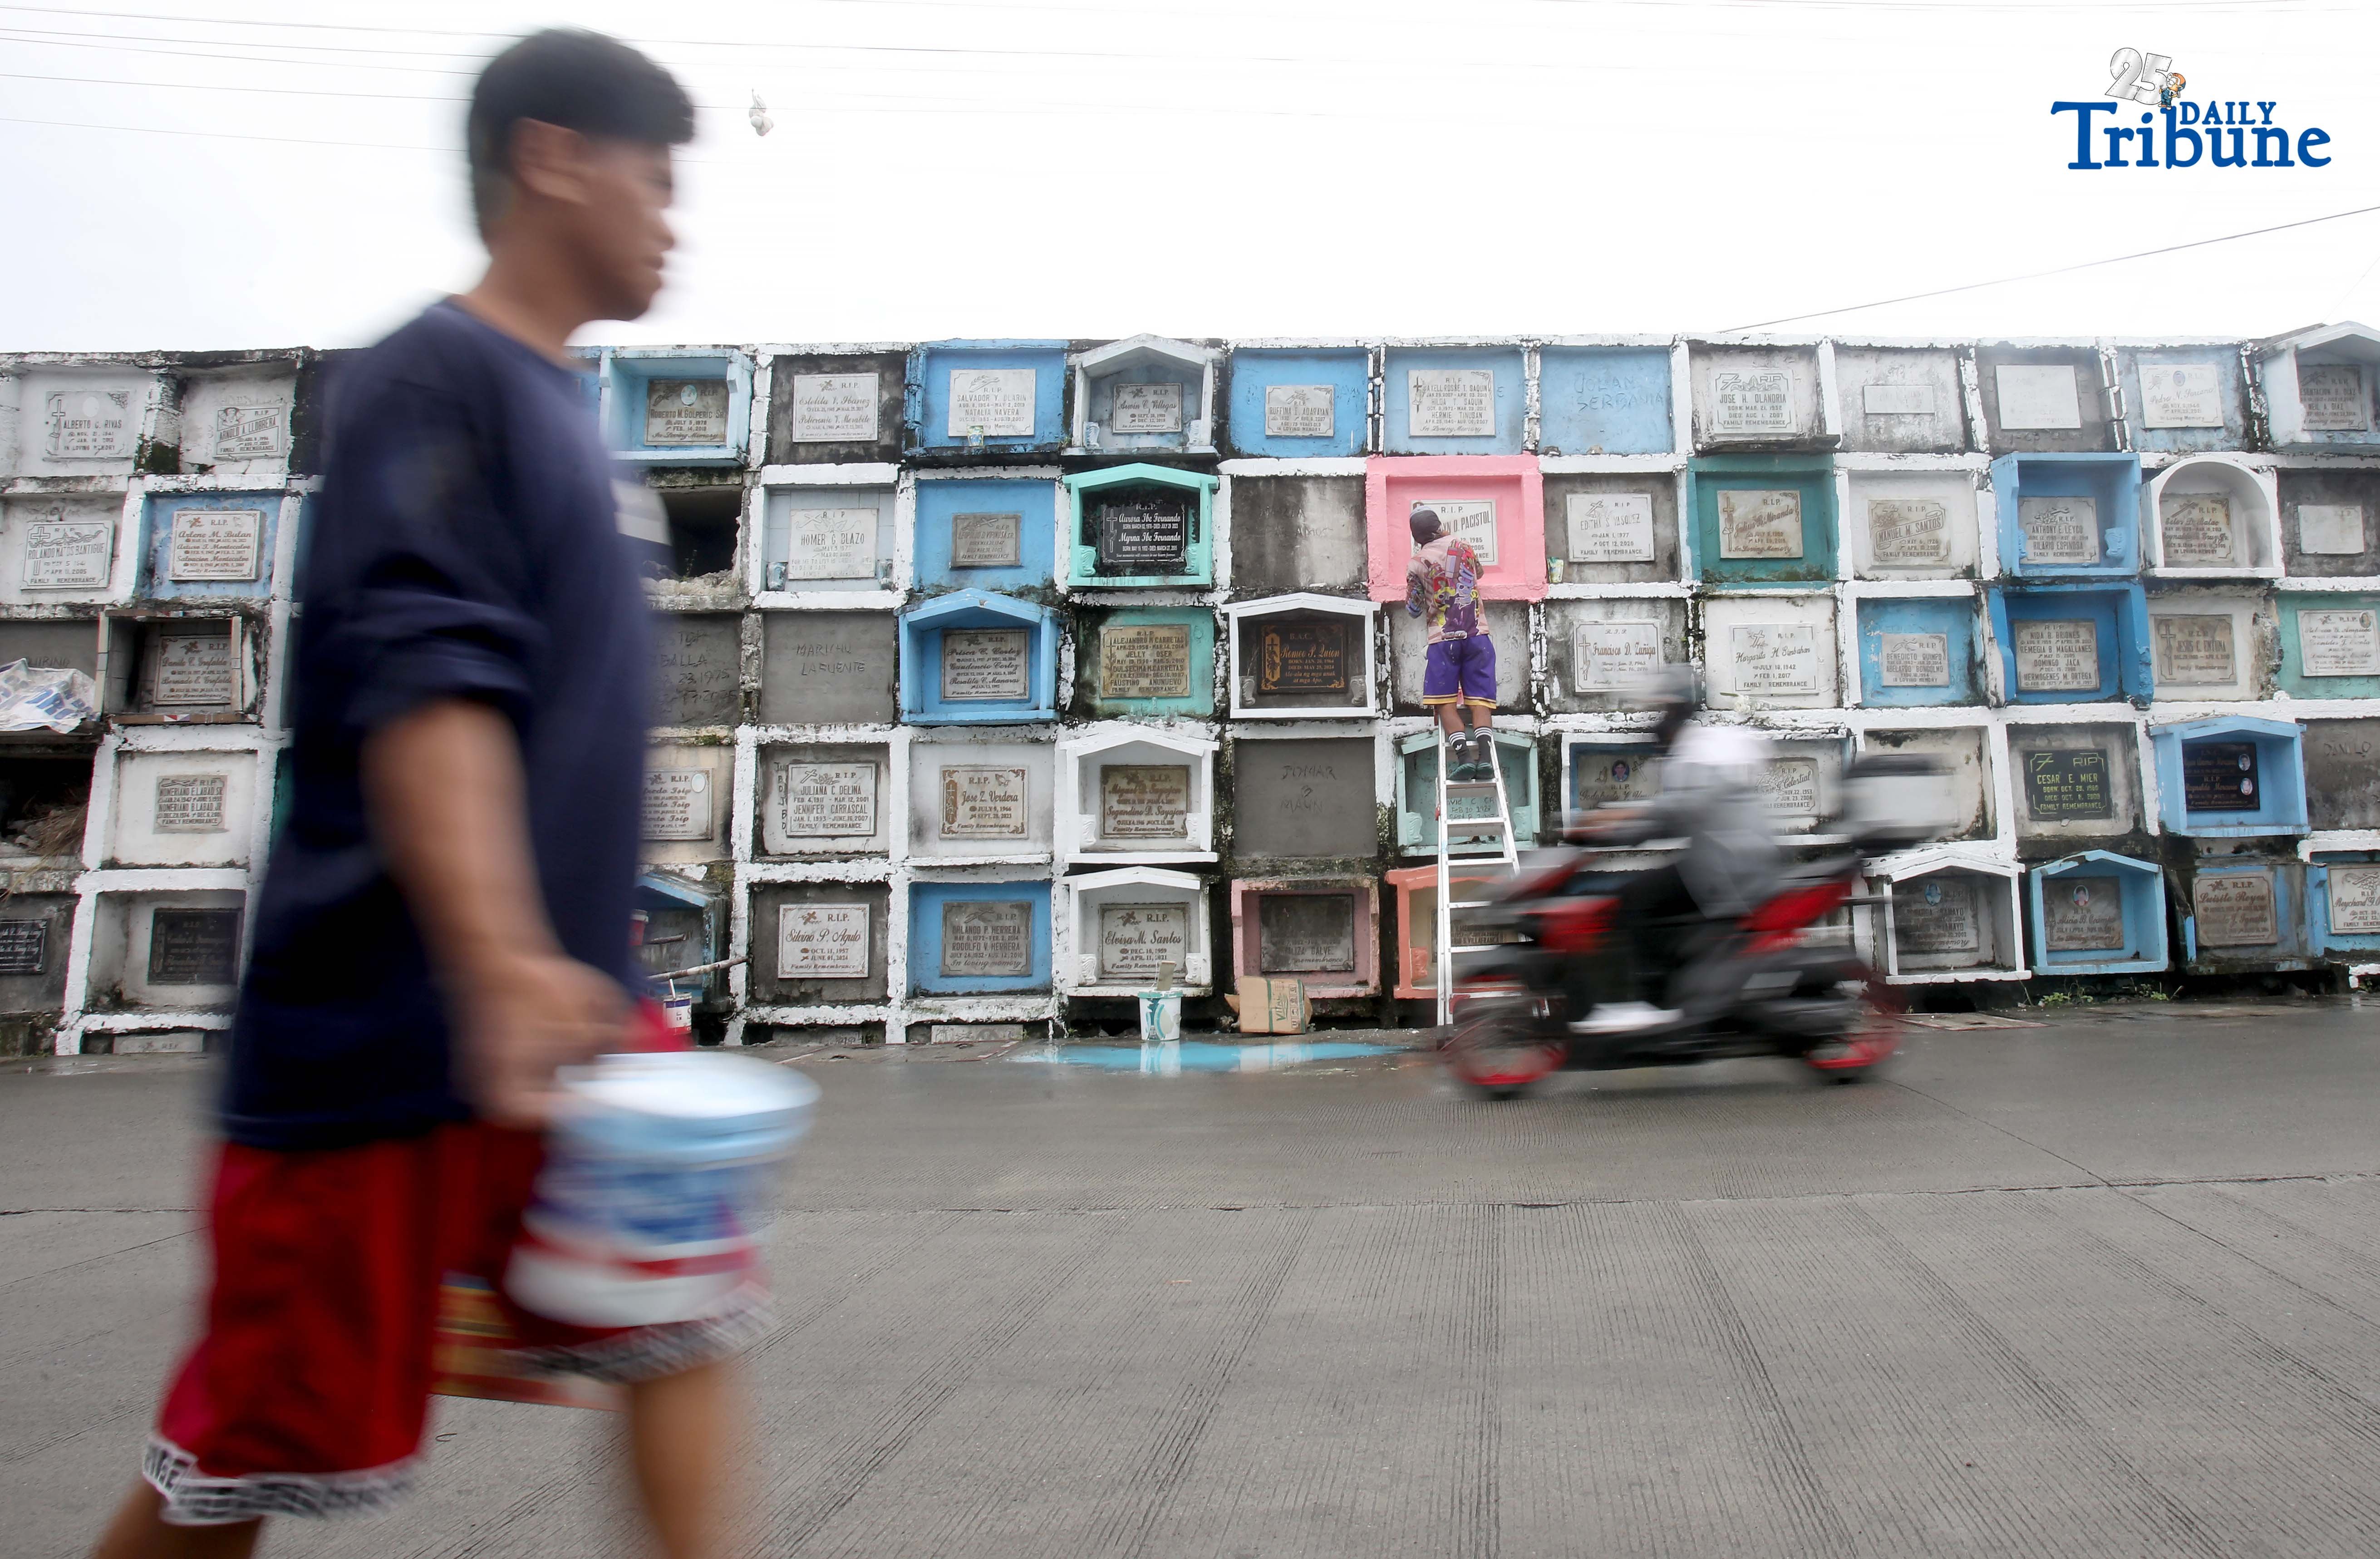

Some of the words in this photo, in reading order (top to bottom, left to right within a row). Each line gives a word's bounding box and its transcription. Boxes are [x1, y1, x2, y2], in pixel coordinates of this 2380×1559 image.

[1720, 394, 1736, 403] JOSE
[1755, 394, 1786, 403] OLANDRIA
[64, 420, 91, 429] ALBERTO
[104, 419, 123, 429] RIVAS
[1119, 513, 1141, 522] Aurora
[1153, 513, 1181, 522] Fernando
[1614, 513, 1641, 526] VASQUEZ
[1765, 505, 1794, 524] Miranda
[1461, 511, 1491, 530] PACISTOL
[1879, 527, 1903, 543] MANUEL
[1916, 518, 1941, 533] SANTOS
[2032, 525, 2056, 533] ANTHONY
[801, 533, 826, 545] HOMER
[841, 533, 865, 544] BLAZO
[1119, 532, 1140, 544] Myrna
[1153, 532, 1181, 542] Fernando
[1280, 646, 1305, 658] Romeo
[1593, 642, 1621, 656] Francisco
[1624, 642, 1631, 656] D.
[2073, 757, 2097, 767] RIP
[2037, 775, 2060, 784] CESAR
[2080, 773, 2098, 783] MIER
[801, 786, 827, 795] JULIANA
[840, 785, 861, 795] DELINA
[961, 791, 978, 806] Jose
[989, 790, 1018, 802] Verdera
[794, 804, 824, 814] JENNIFER
[831, 804, 867, 814] CARRASCAL
[1147, 913, 1169, 922] R.I.P.
[952, 926, 980, 934] ORLANDO
[992, 926, 1020, 934] HERRERA
[786, 929, 814, 942] Silvino
[817, 929, 830, 942] P.
[832, 928, 861, 946] Agulo
[1105, 931, 1134, 944] Elvira
[1151, 930, 1182, 944] Santos
[952, 942, 980, 951] RODOLFO
[991, 942, 1020, 951] HERRERA
